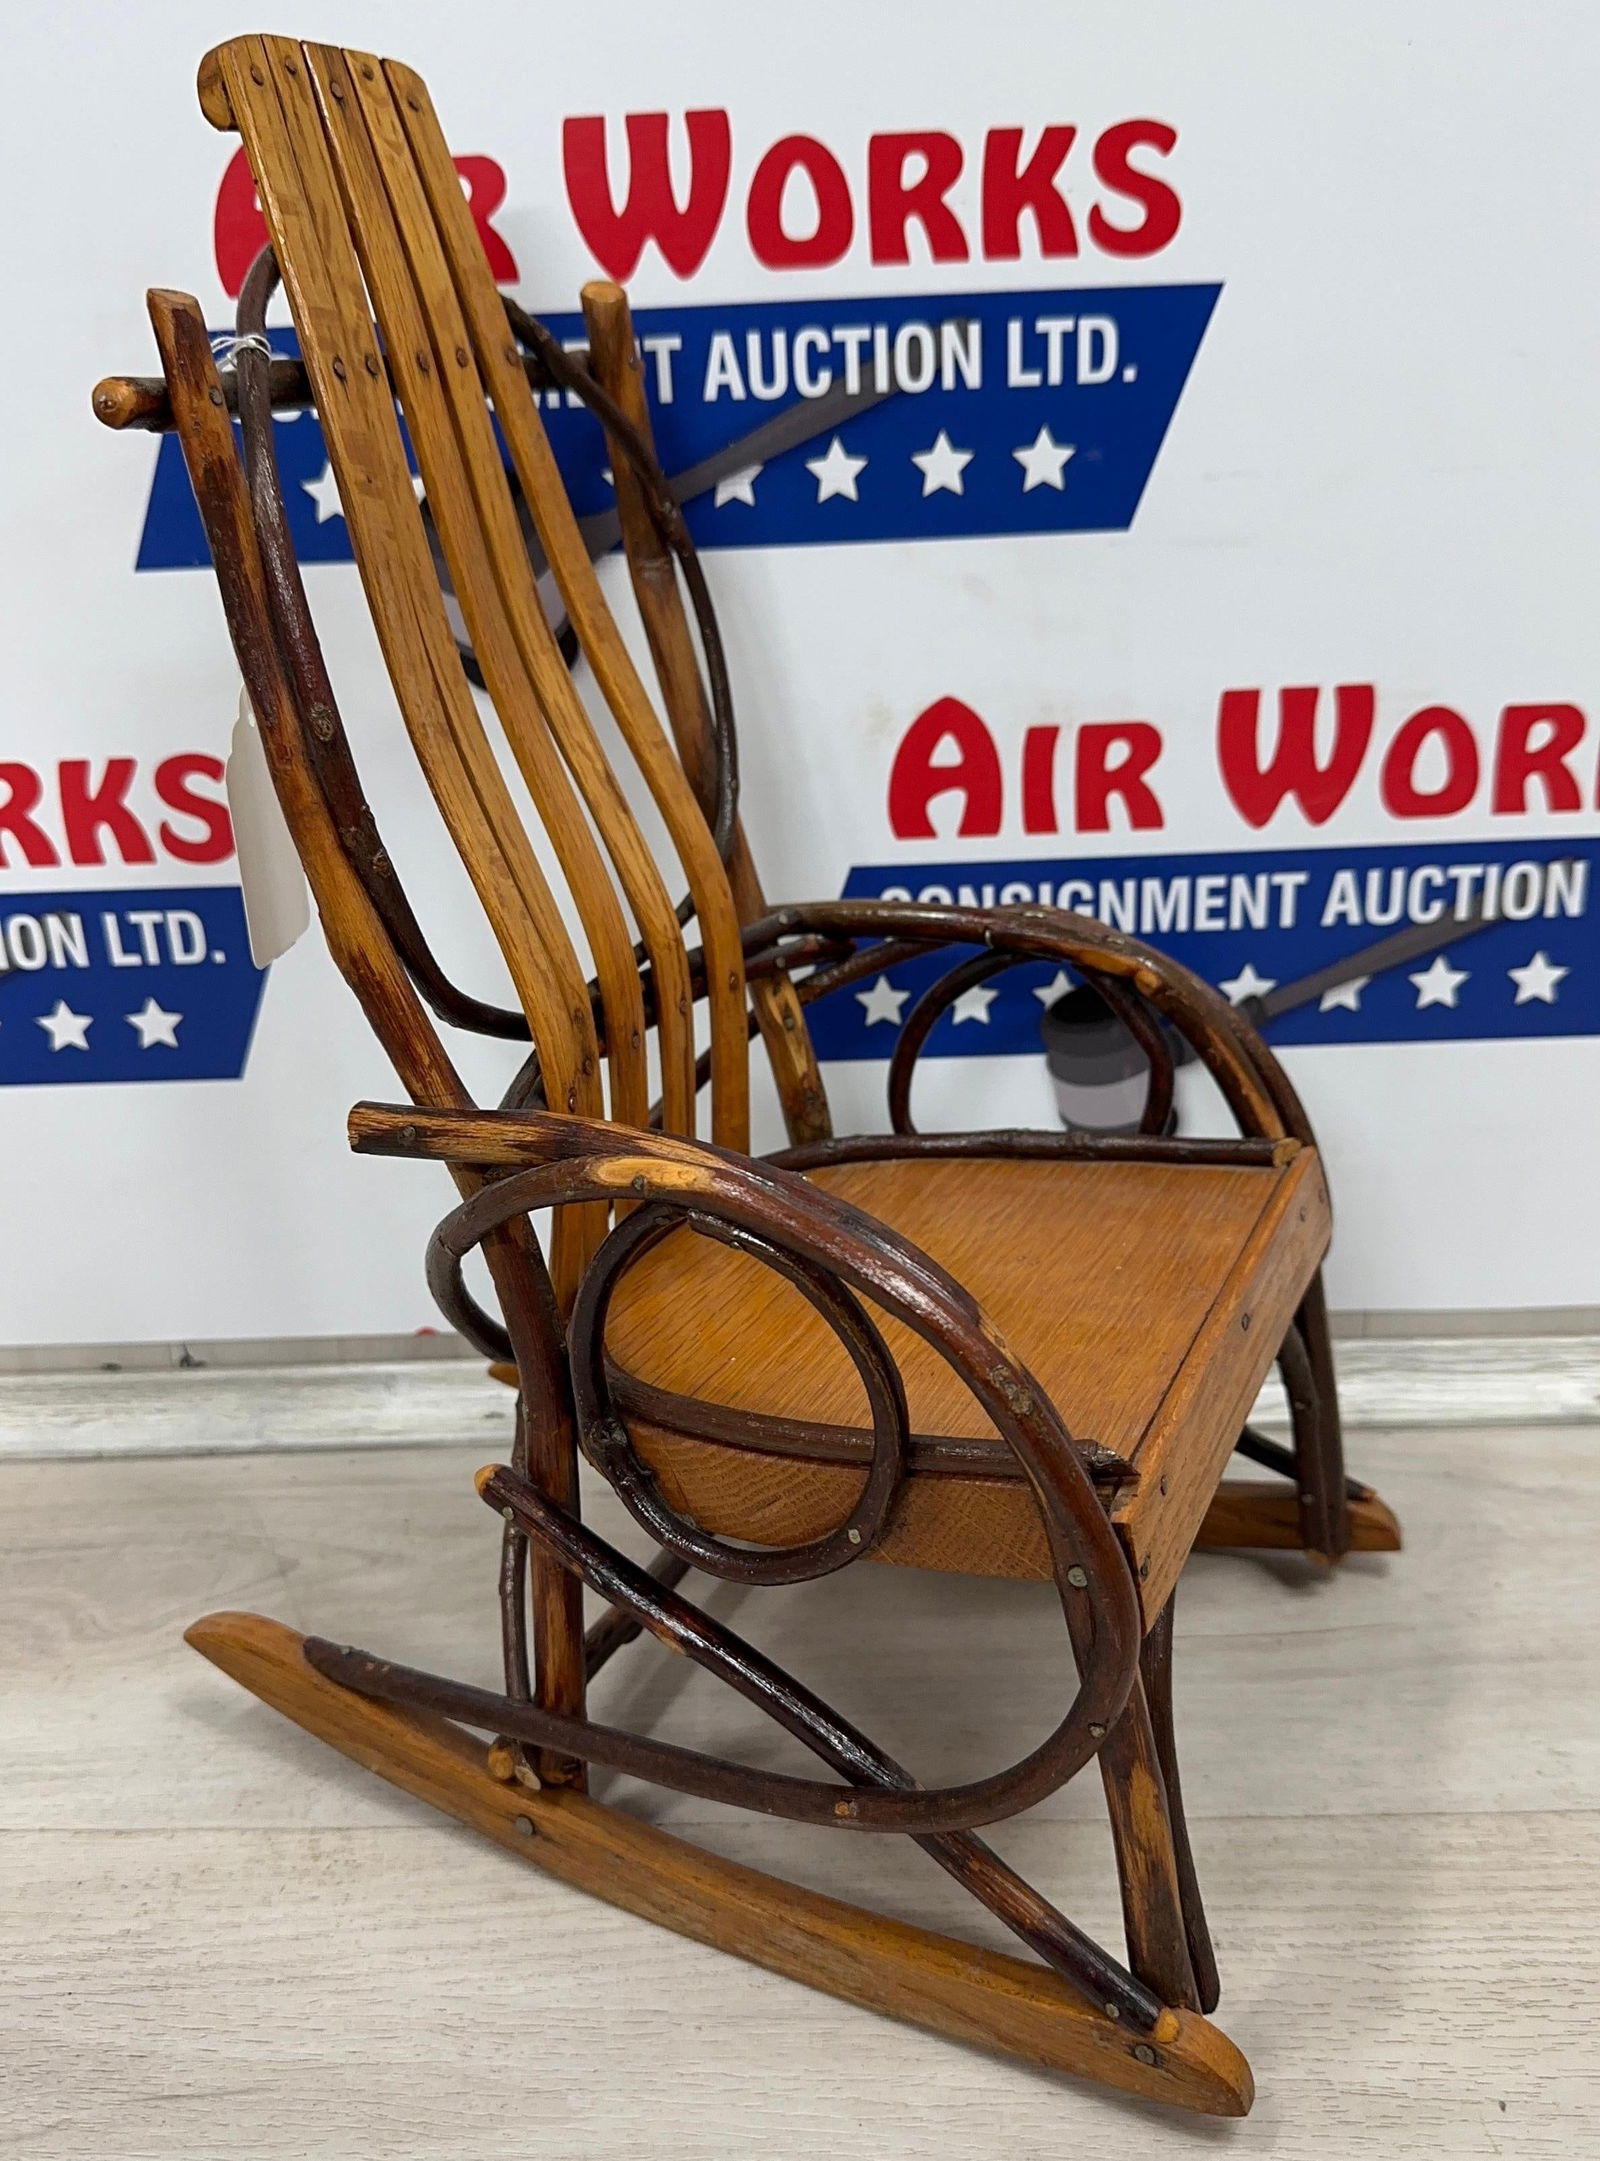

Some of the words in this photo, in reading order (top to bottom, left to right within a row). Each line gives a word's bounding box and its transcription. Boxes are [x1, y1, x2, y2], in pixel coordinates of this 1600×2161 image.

[561, 107, 1183, 285] WORKS
[703, 319, 983, 404] AUCTION
[1006, 314, 1138, 389] LTD.
[886, 695, 1166, 842] AIR
[1216, 682, 1600, 830] WOR
[1319, 858, 1589, 928] AUCTION
[102, 909, 227, 968] LTD.
